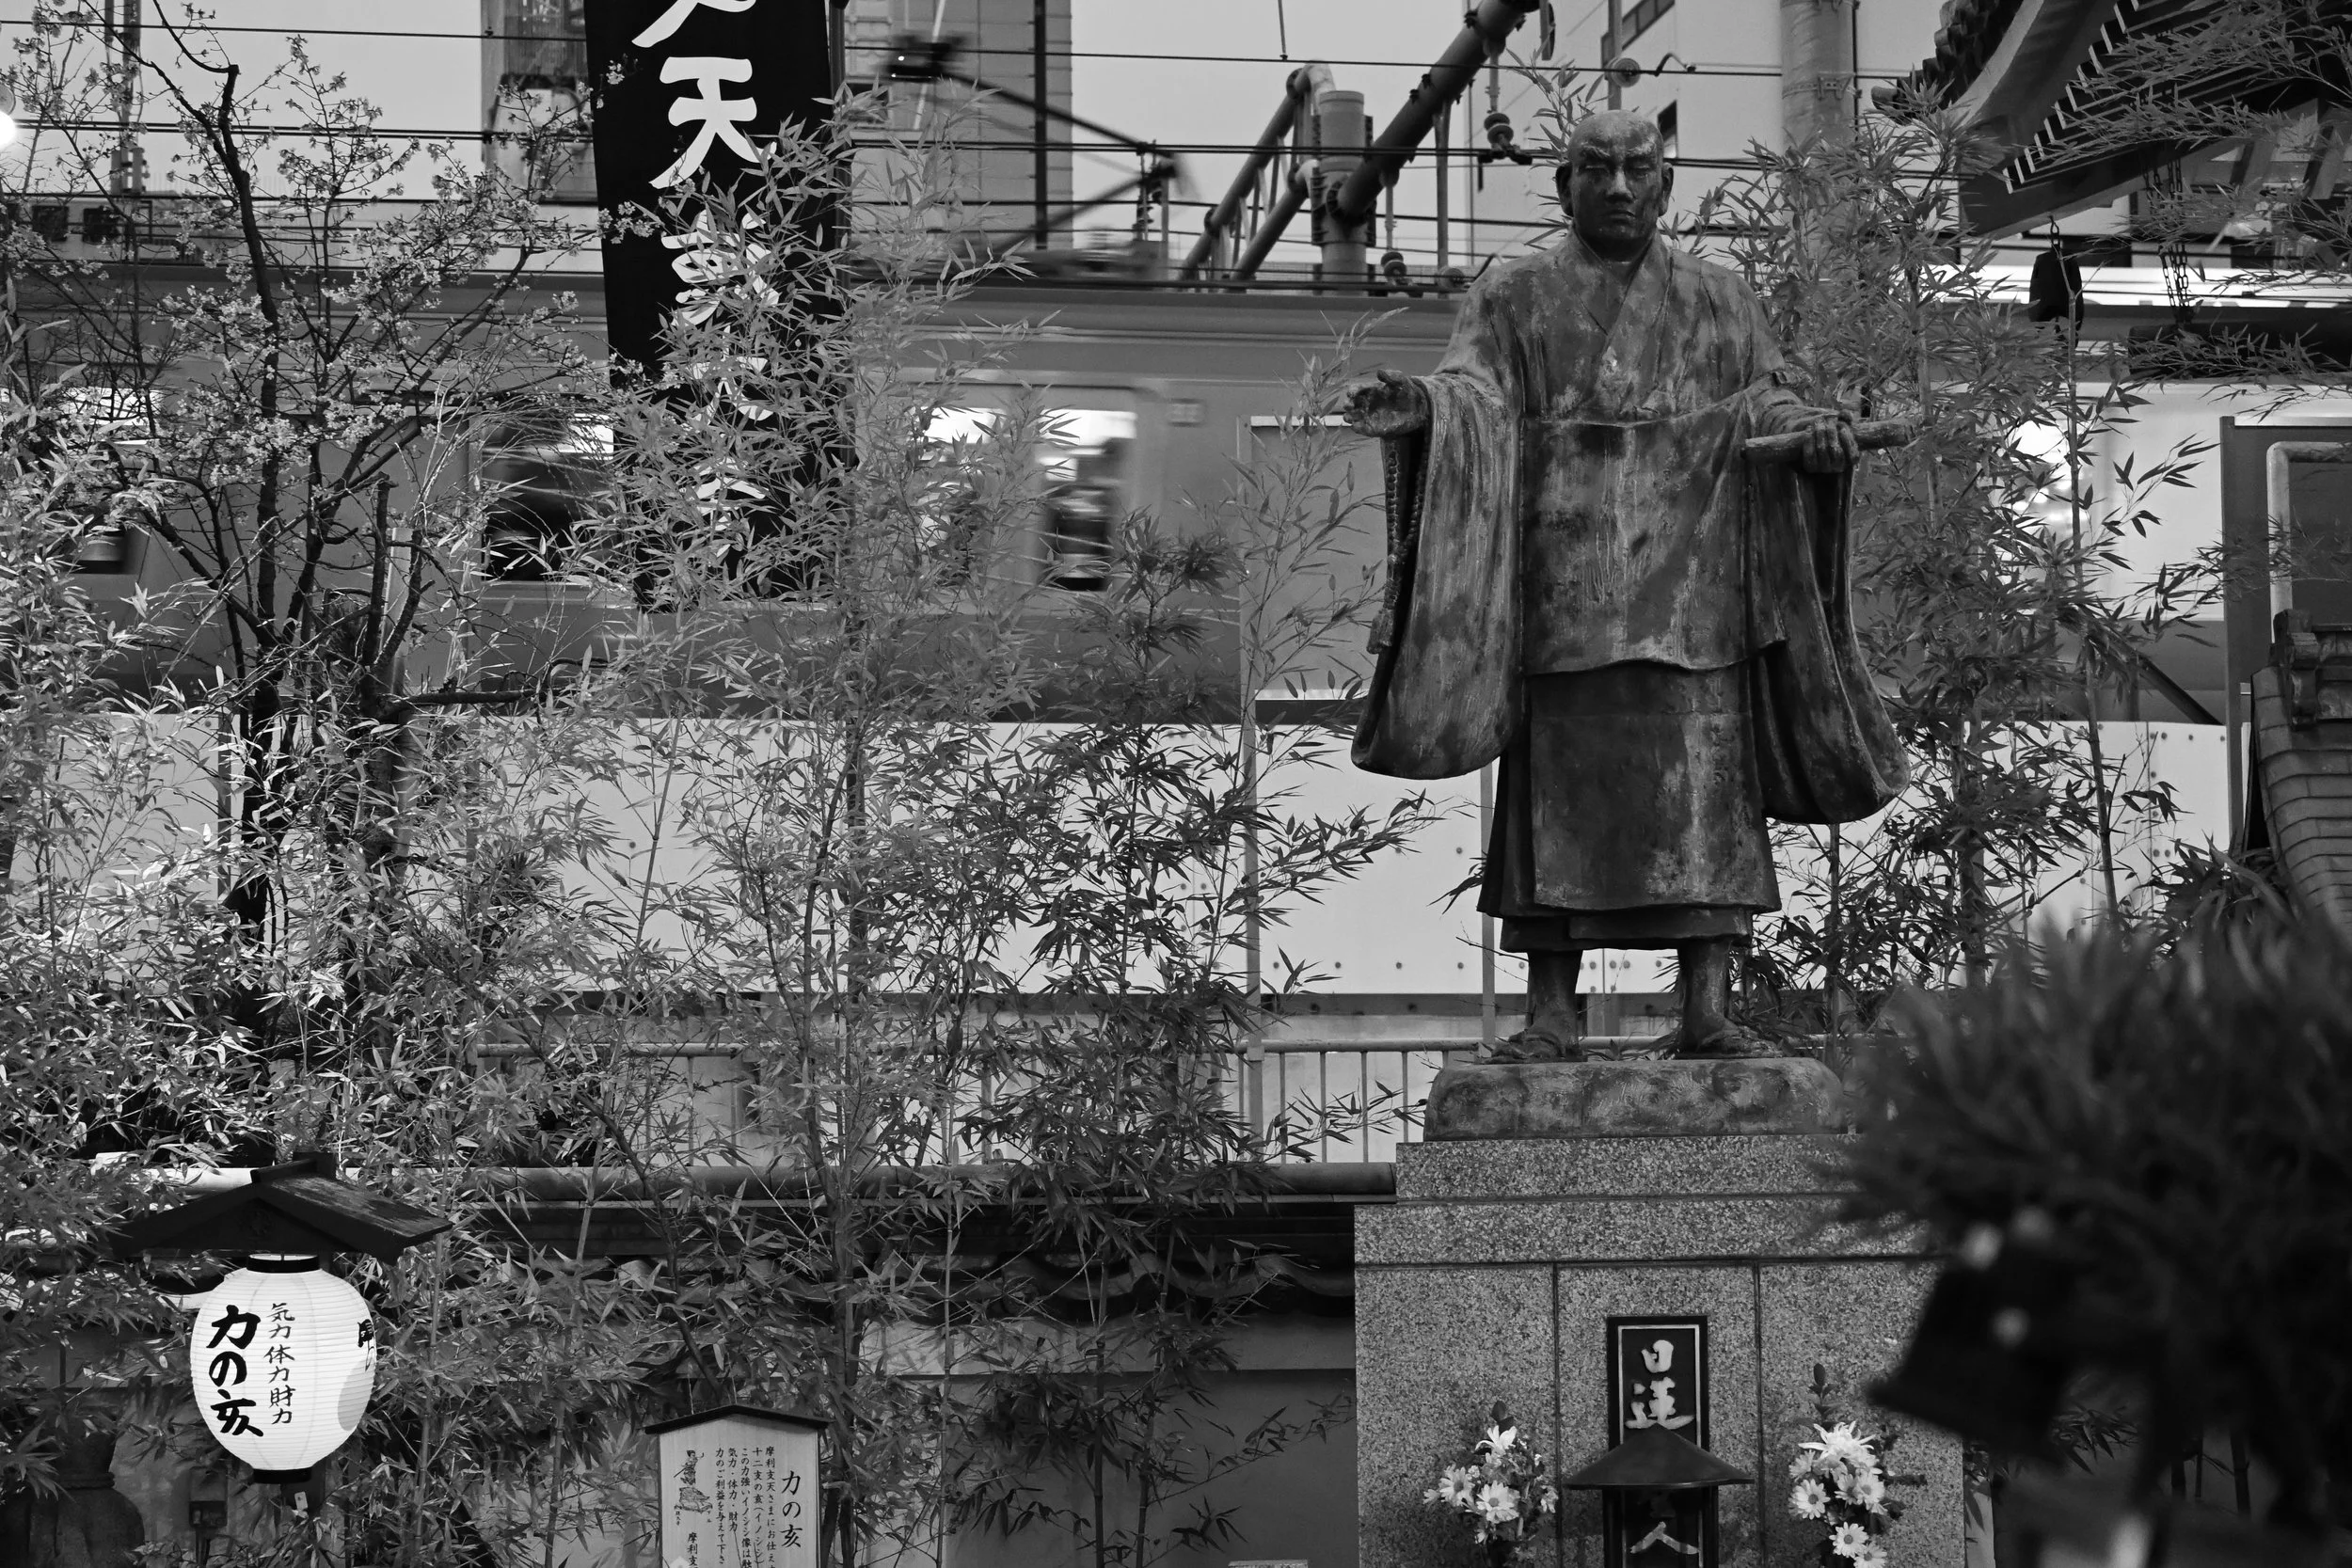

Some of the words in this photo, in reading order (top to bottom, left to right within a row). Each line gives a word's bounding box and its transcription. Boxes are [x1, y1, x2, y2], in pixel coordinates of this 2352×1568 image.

[206, 1305, 263, 1437] 力の亥
[263, 1303, 295, 1425] 気力体力財力
[687, 1532, 698, 1568] 摩利支
[766, 1446, 776, 1568] 摩利支天さまにお仕え
[781, 1470, 803, 1548] 力の亥
